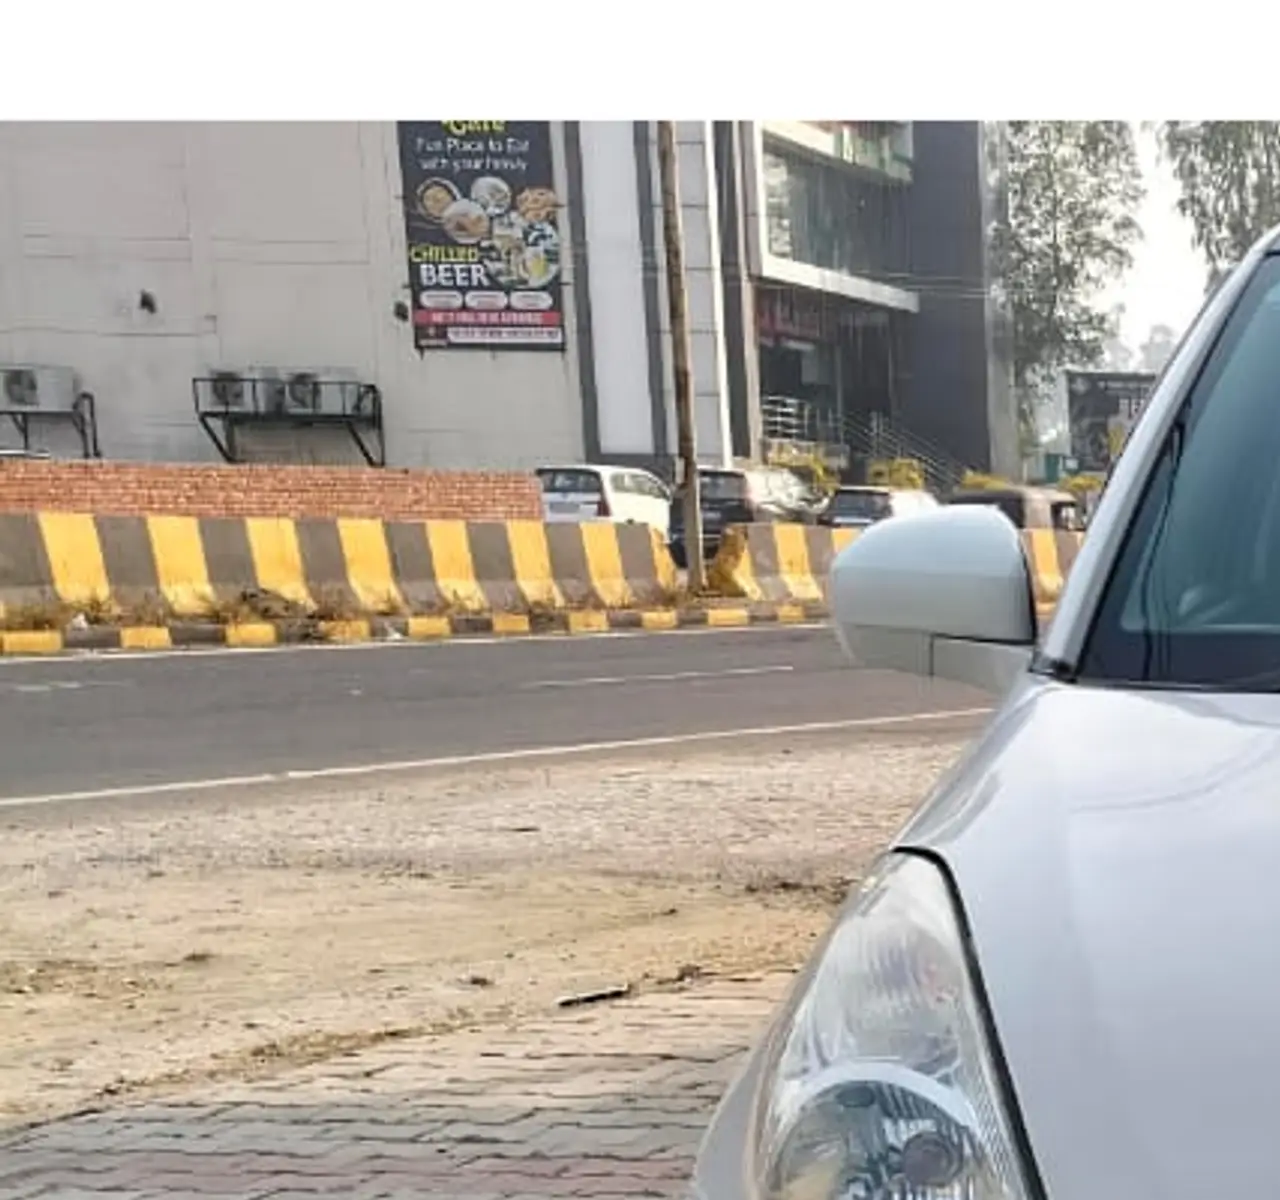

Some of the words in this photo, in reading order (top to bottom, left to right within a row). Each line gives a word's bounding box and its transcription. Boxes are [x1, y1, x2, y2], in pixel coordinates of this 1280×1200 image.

[446, 137, 484, 155] Place
[488, 137, 504, 153] to
[507, 138, 530, 153] Eat
[420, 156, 448, 170] with
[453, 157, 484, 173] your
[485, 154, 529, 171] family
[411, 244, 479, 262] CHILLED
[420, 263, 490, 286] BEER
